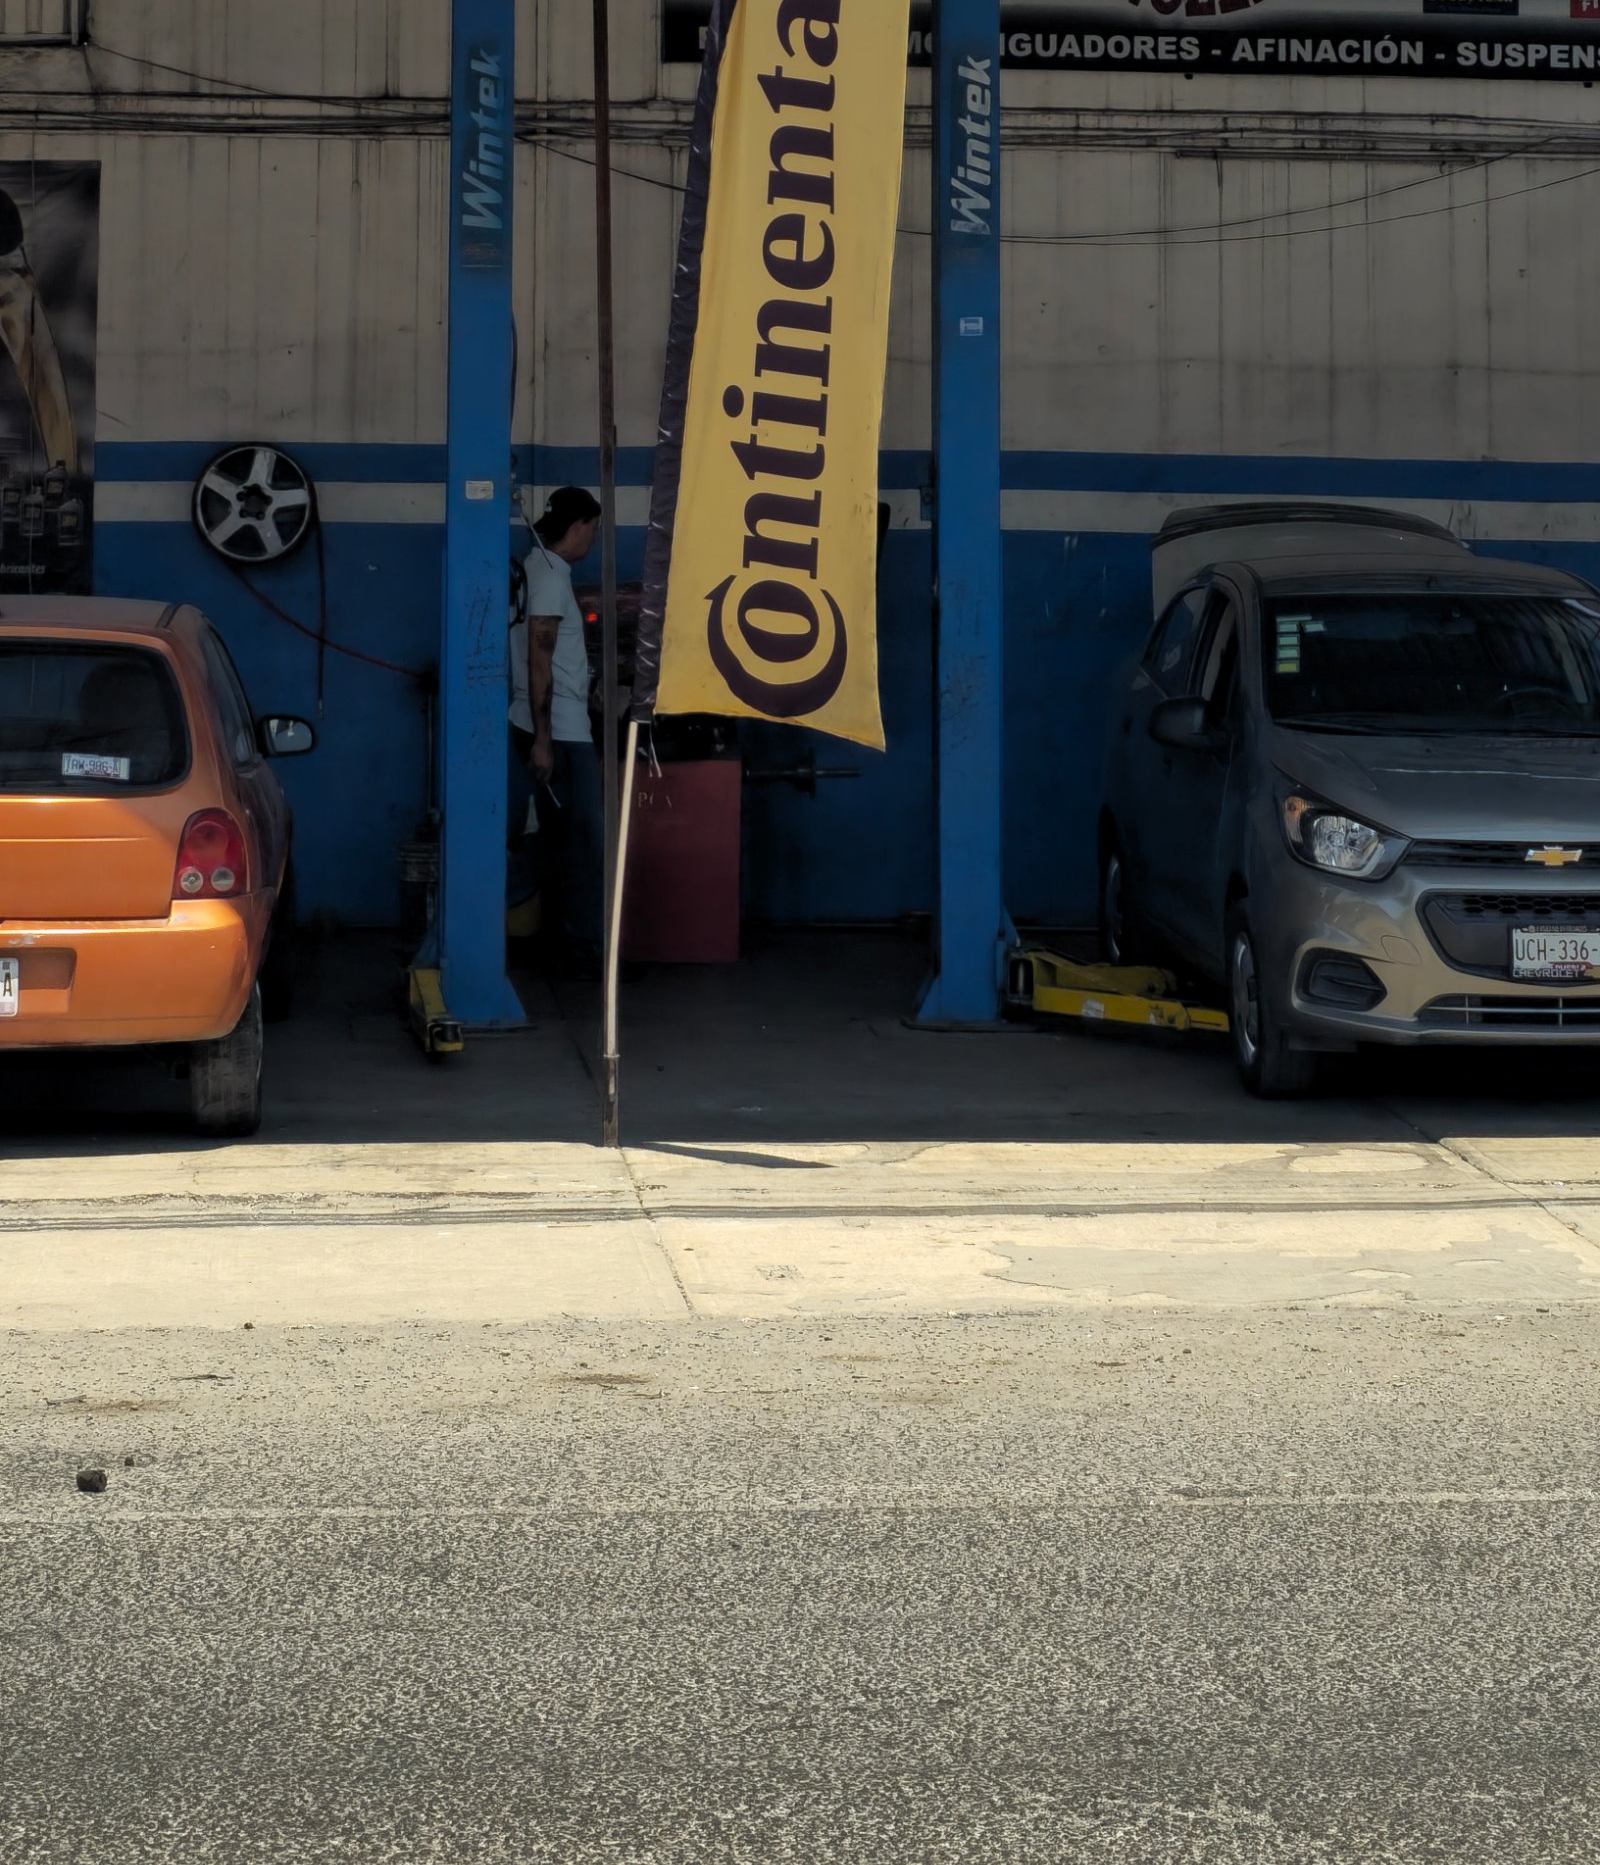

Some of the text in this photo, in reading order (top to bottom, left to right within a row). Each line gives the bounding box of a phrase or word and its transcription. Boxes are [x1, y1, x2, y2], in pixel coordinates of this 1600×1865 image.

[461, 47, 505, 229] Wintek
[1232, 34, 1424, 66] AFINACIÓN
[950, 55, 991, 235] Wintek
